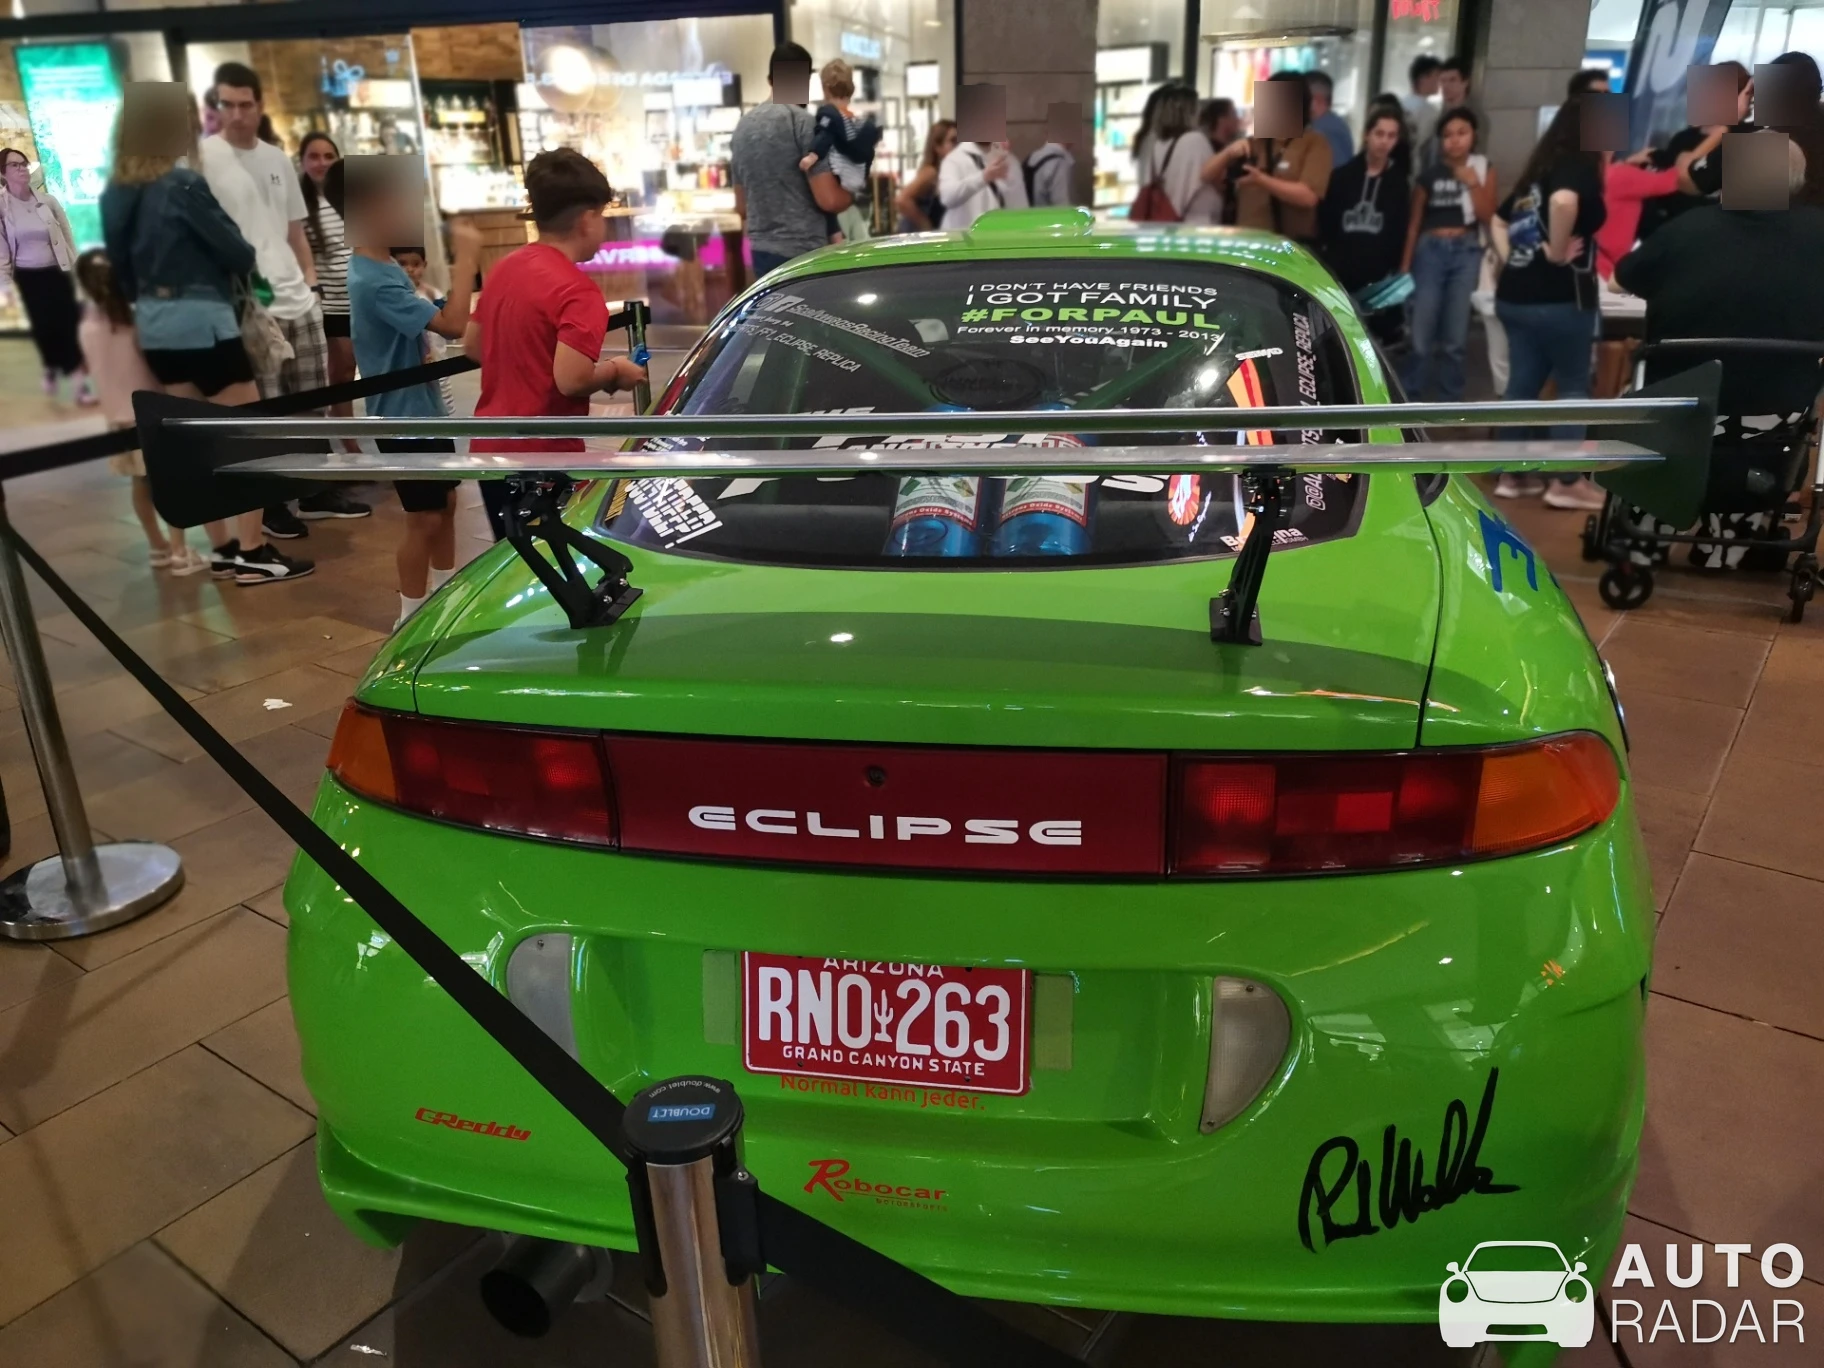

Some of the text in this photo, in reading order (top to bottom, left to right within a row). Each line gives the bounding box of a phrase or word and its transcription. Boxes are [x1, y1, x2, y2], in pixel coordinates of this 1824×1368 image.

[966, 292, 1217, 310] I GOT FAMILY
[969, 282, 1217, 297] I DON'T HAVE FRIENDS
[960, 307, 1221, 330] #FORPAUL
[956, 324, 1022, 334] Forever
[1026, 325, 1040, 333] in
[1045, 325, 1115, 336] memory
[1121, 326, 1161, 336] 1973
[1178, 330, 1221, 342] 2013
[1009, 334, 1168, 349] SeeYouAgain
[688, 805, 1082, 845] ECLIPSE
[822, 957, 944, 979] ARIZONA
[758, 966, 1011, 1062] RNO 263
[782, 1045, 985, 1076] GRAND CANYON STATE
[780, 1075, 986, 1110] Normal kann jeder.
[414, 1107, 532, 1141] GReddy
[652, 1106, 711, 1119] DOUBLET
[803, 1158, 947, 1202] Robocar
